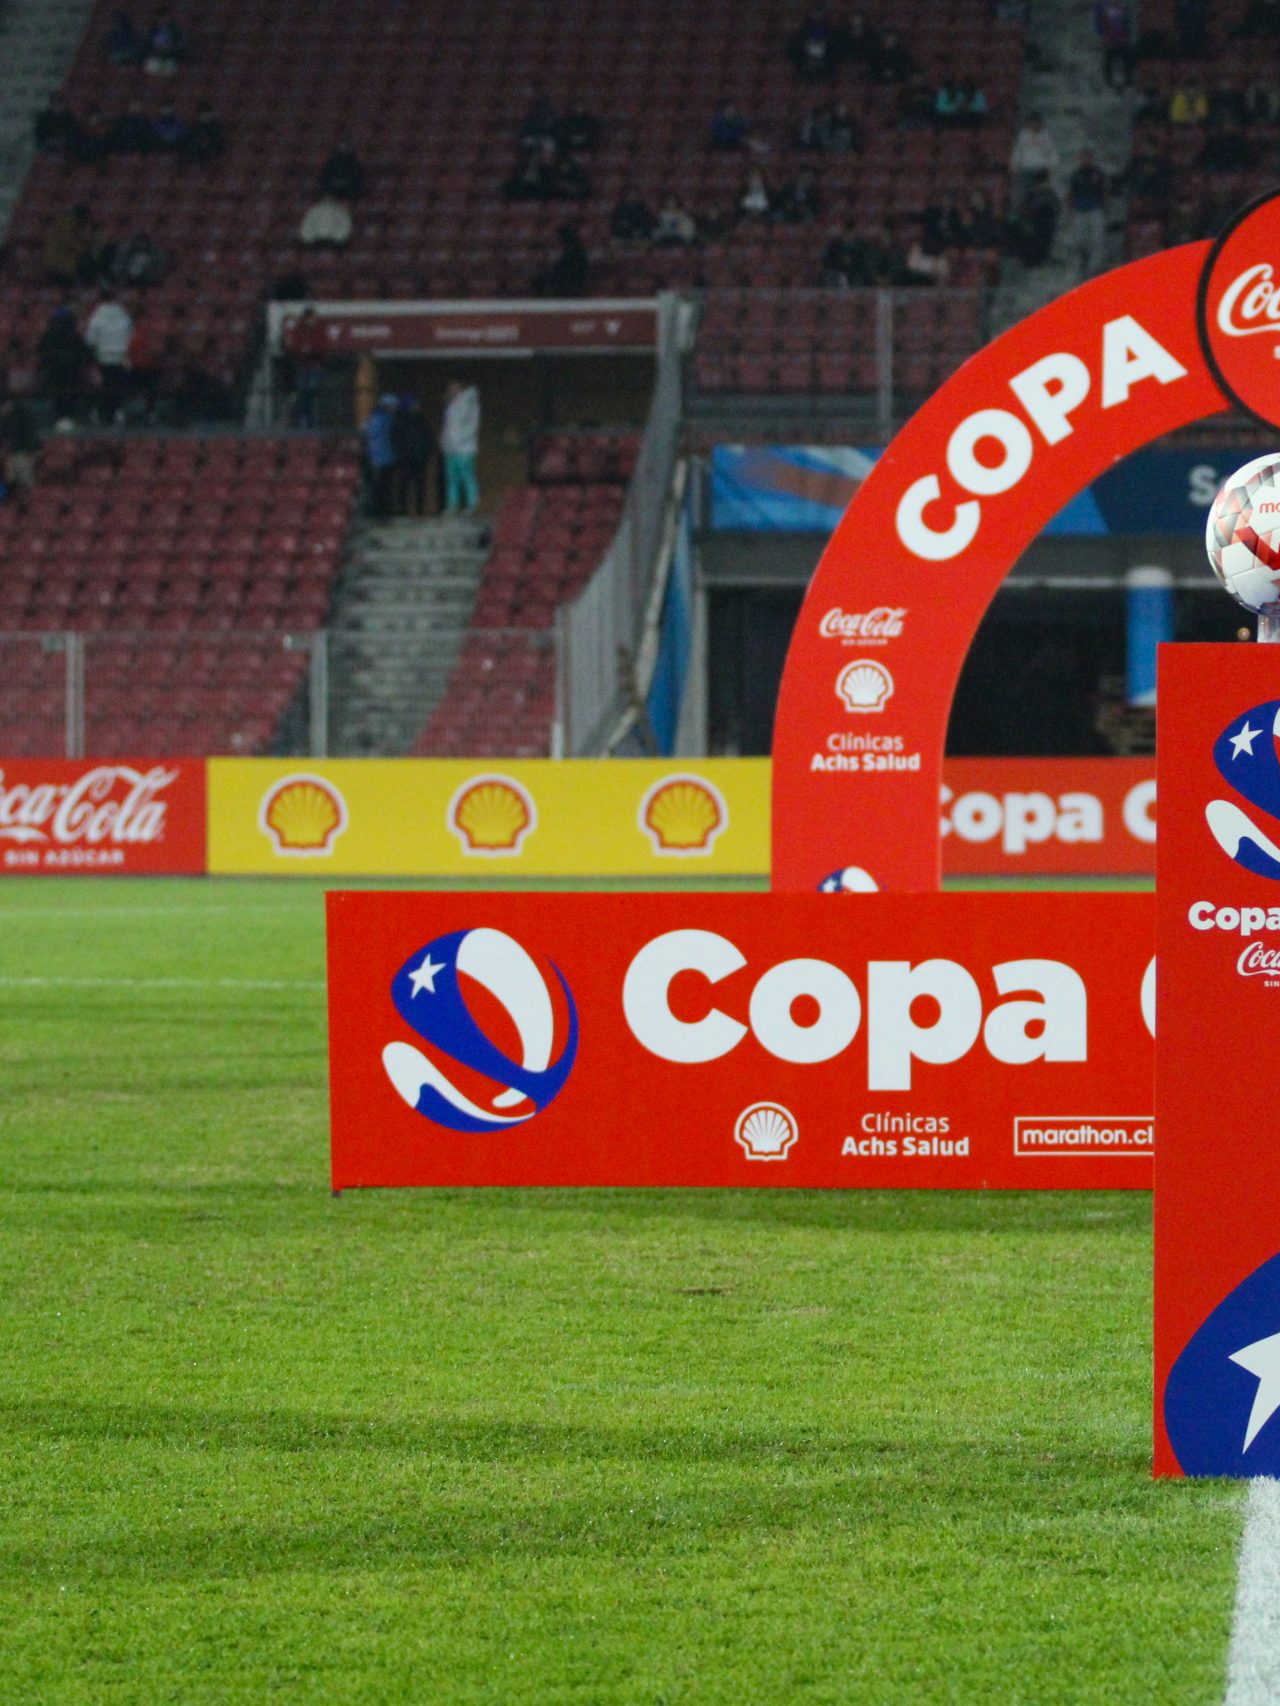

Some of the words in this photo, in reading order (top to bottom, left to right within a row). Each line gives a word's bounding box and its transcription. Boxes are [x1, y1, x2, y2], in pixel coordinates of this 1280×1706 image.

[896, 314, 1188, 561] COPA
[819, 607, 908, 637] Coca-Cola
[827, 732, 904, 751] Clínicas
[811, 753, 859, 771] Achs
[863, 752, 921, 771] Salud
[0, 766, 180, 843] ca-Cola
[940, 784, 1104, 854] opa
[622, 929, 1087, 1091] Copa
[861, 1112, 950, 1133] Clínicas
[1023, 1125, 1153, 1144] marathon.cl
[841, 1137, 897, 1156] Achs
[902, 1136, 969, 1156] Salud
